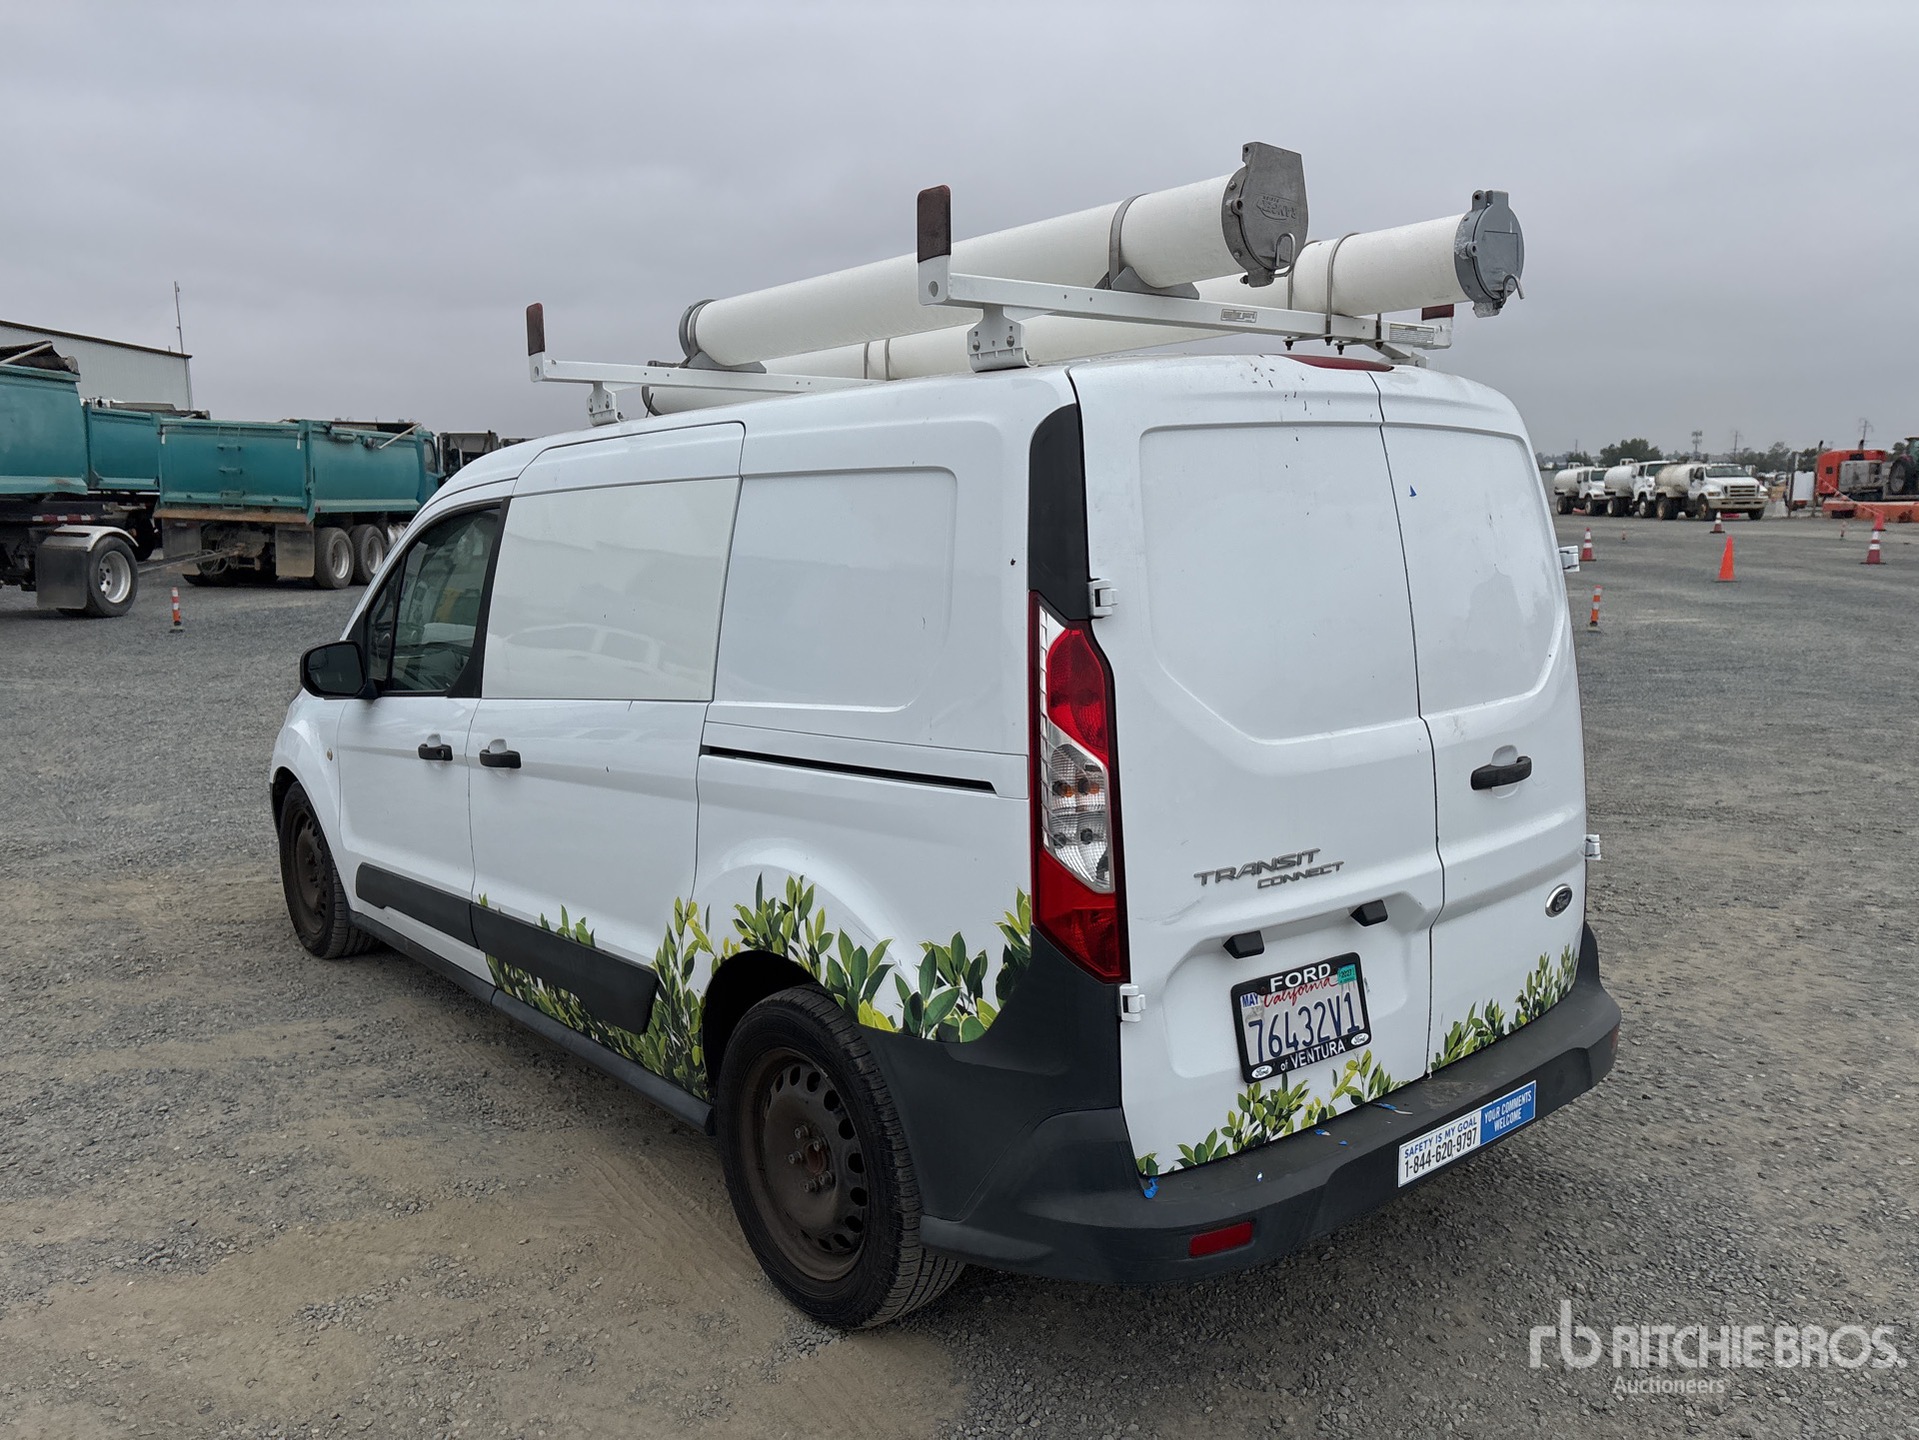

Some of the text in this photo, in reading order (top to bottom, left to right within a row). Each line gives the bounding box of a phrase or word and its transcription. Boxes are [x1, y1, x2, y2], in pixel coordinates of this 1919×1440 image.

[1193, 848, 1321, 886] TRANSIT
[1257, 861, 1344, 889] CONNECT
[1263, 977, 1338, 1008] California
[1270, 963, 1331, 992] FORD
[1242, 992, 1259, 1008] MAY
[1248, 992, 1360, 1062] 76432V1
[1280, 1041, 1346, 1071] of VENTURA
[1485, 1090, 1532, 1124] YOUR COMMENTS
[1494, 1108, 1522, 1132] WELCOME
[1404, 1116, 1477, 1158] SAFETY IS MY GOAL
[1404, 1127, 1478, 1178] 1-844-620-9797
